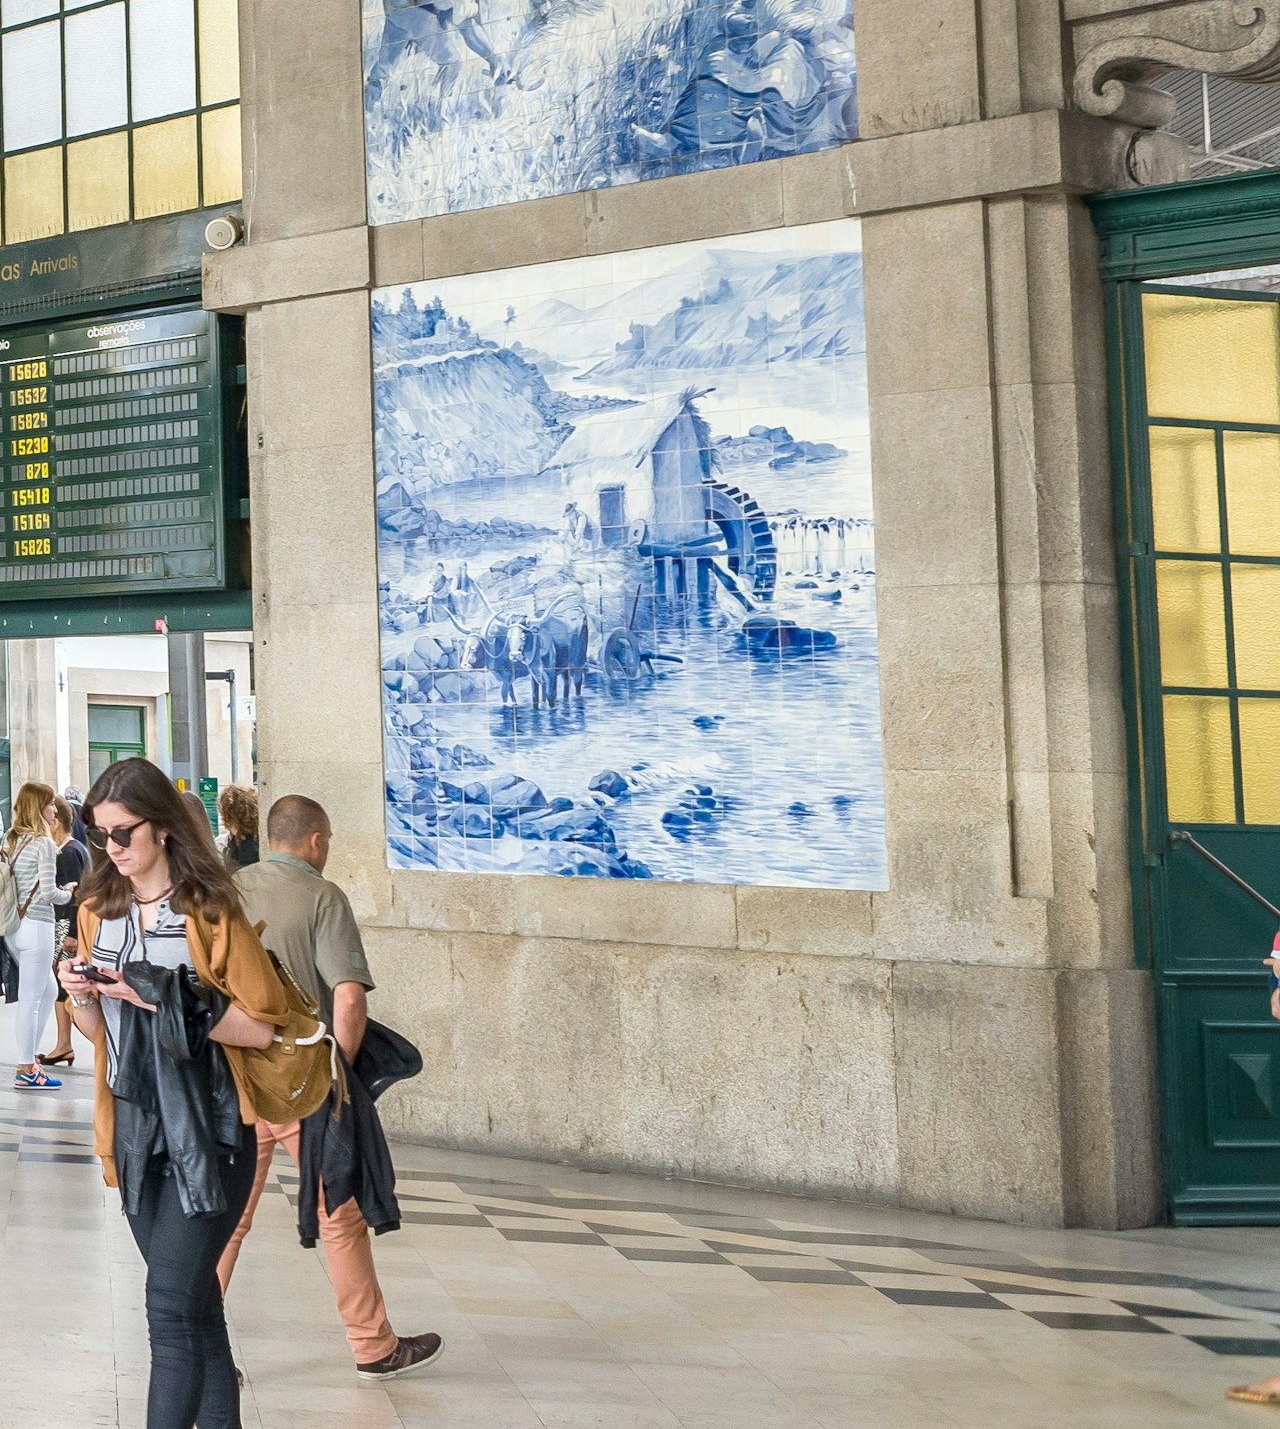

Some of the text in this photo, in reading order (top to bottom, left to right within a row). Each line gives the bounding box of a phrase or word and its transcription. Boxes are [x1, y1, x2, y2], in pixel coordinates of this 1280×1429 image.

[29, 254, 77, 277] Arrivals
[87, 320, 146, 340] observações
[99, 336, 130, 349] remarks
[9, 361, 47, 381] 15628
[10, 386, 47, 407] 15532
[10, 411, 48, 432] 15824
[11, 437, 49, 457] 15230
[26, 462, 49, 480] 870
[12, 487, 50, 507] 15418
[12, 513, 51, 532] 15164
[14, 538, 51, 557] 15826
